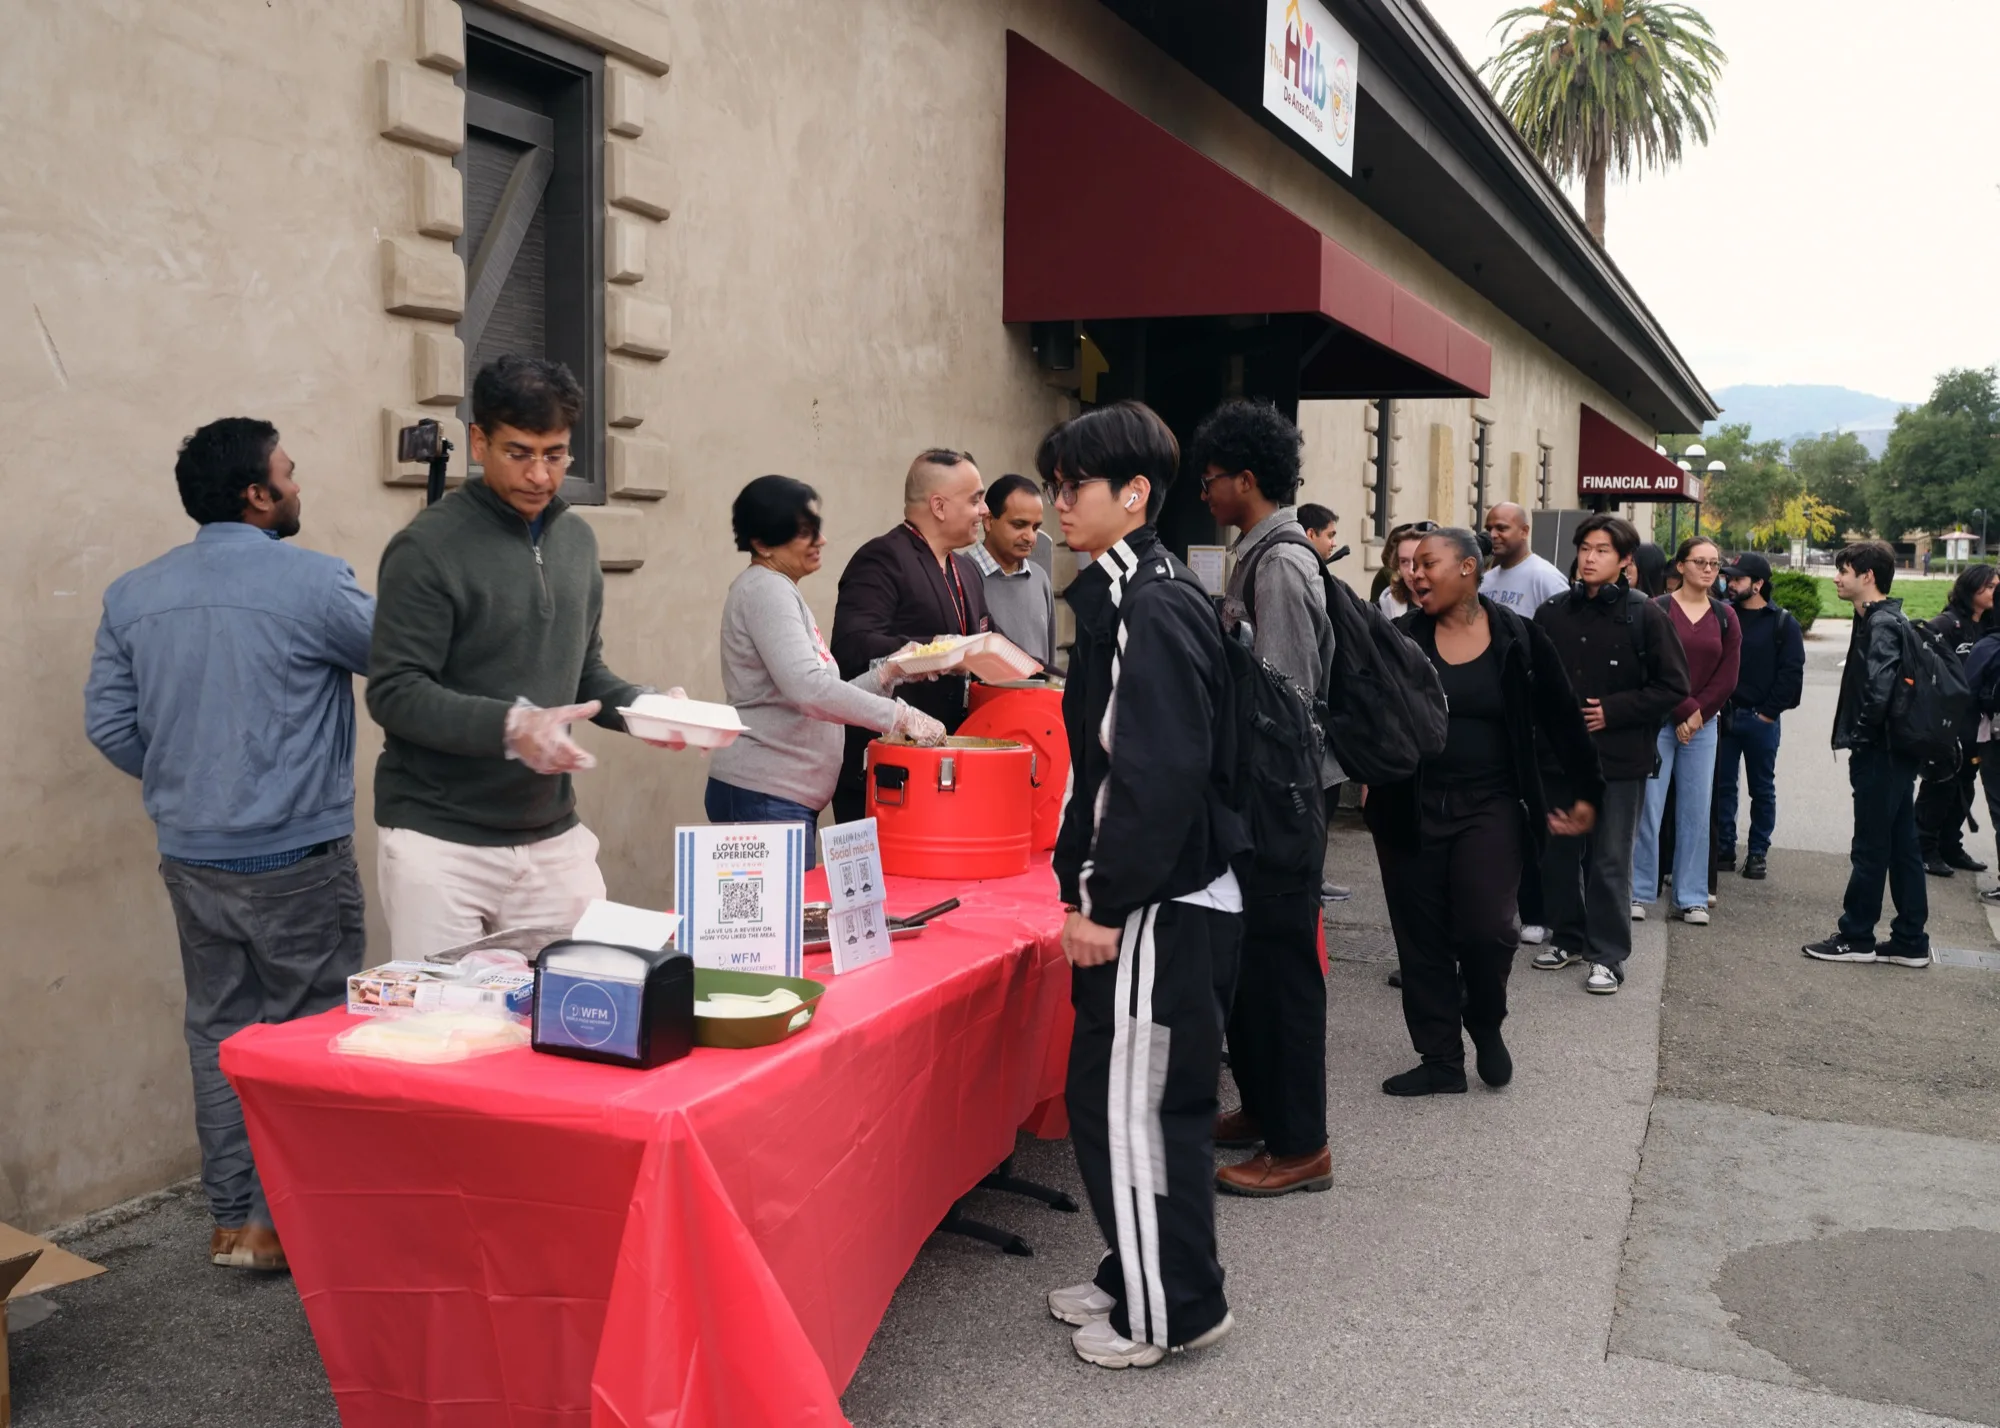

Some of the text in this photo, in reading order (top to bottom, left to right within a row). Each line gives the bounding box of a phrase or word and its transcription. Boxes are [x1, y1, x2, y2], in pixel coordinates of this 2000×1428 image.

[1269, 42, 1283, 73] The
[1284, 21, 1326, 111] Hub
[1284, 85, 1292, 105] De
[1292, 93, 1305, 117] Anza
[1305, 104, 1324, 132] College
[1582, 476, 1651, 489] FINANCIAL
[1654, 476, 1678, 489] AID
[716, 842, 766, 852] LOVE YOUR
[830, 840, 875, 861] Social media
[712, 850, 770, 860] EXPERIENCE?
[731, 952, 761, 964] WFM
[582, 1006, 608, 1020] WFM
